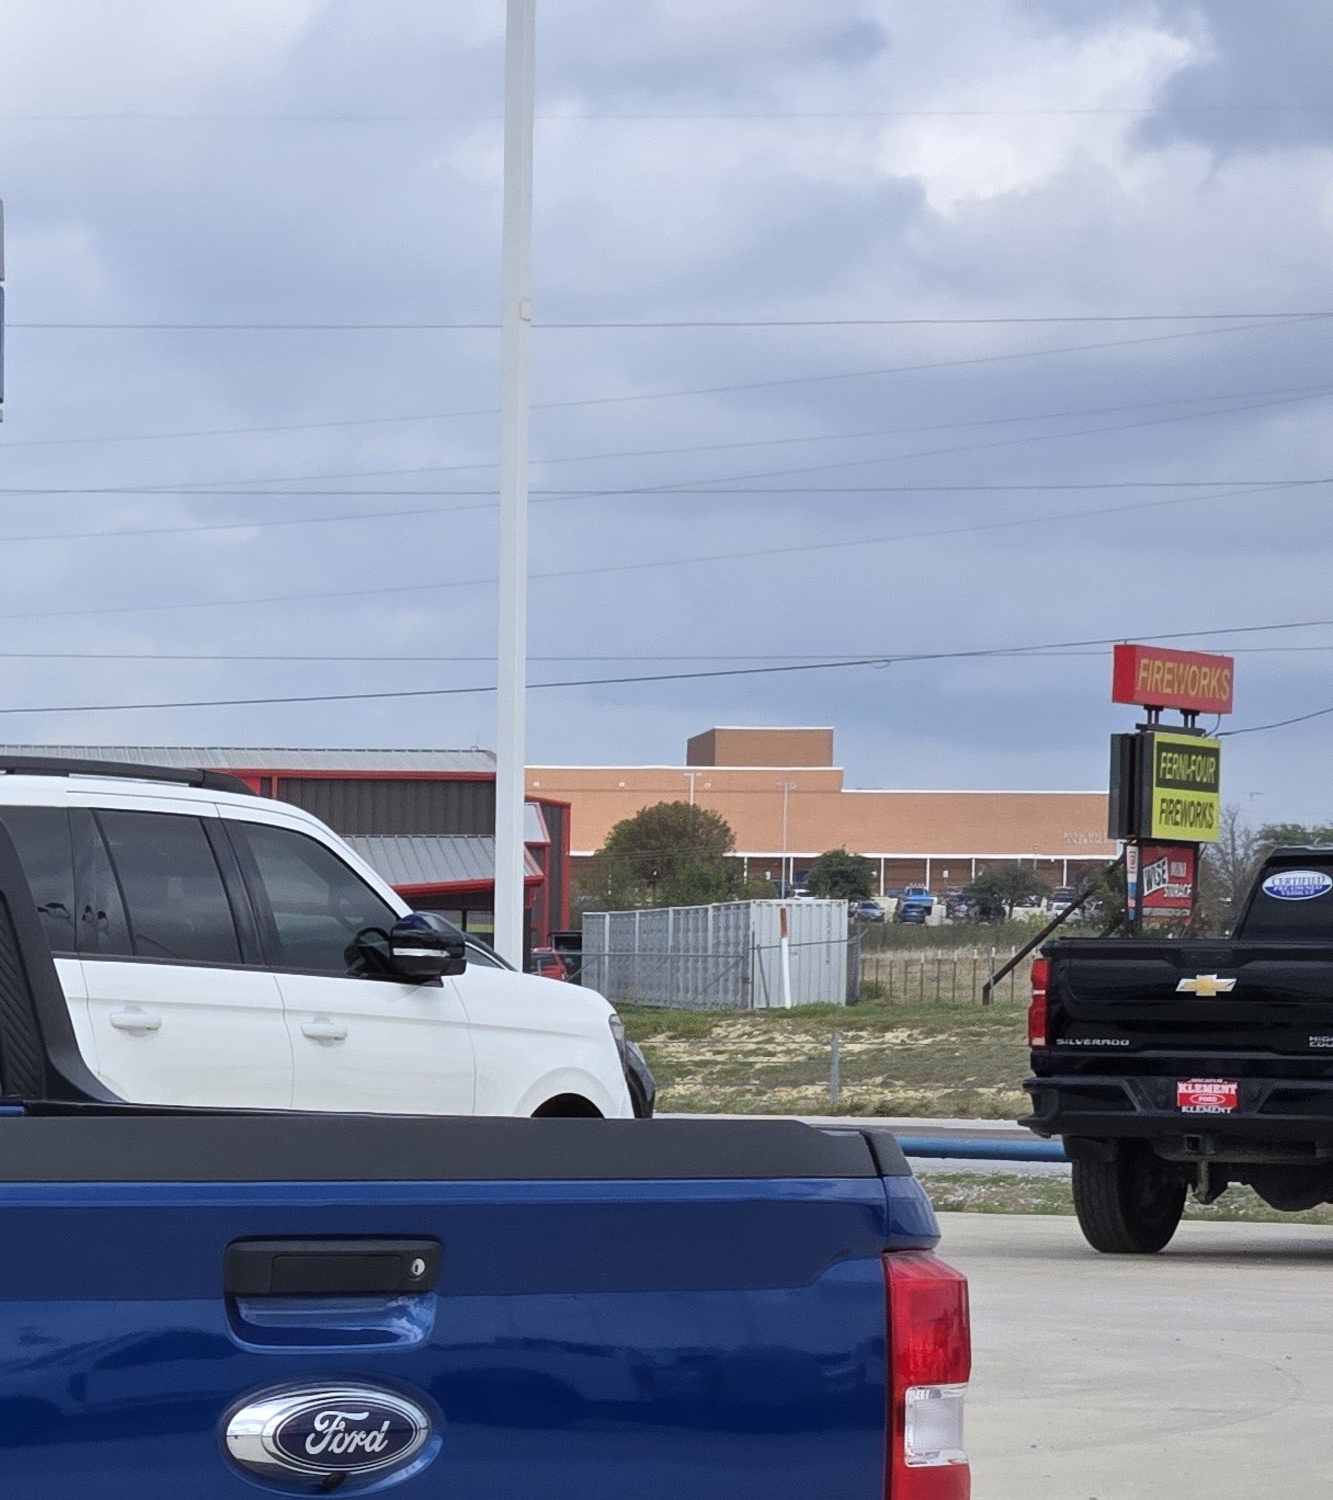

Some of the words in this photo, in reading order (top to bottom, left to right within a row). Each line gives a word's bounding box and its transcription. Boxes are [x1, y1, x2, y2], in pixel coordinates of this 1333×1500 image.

[1138, 658, 1231, 701] FIREWORKS
[1159, 798, 1215, 829] FIREWORKS
[1056, 1038, 1130, 1046] SILVERADO
[1177, 1082, 1237, 1094] KLEMENT
[305, 1410, 391, 1455] Ford
